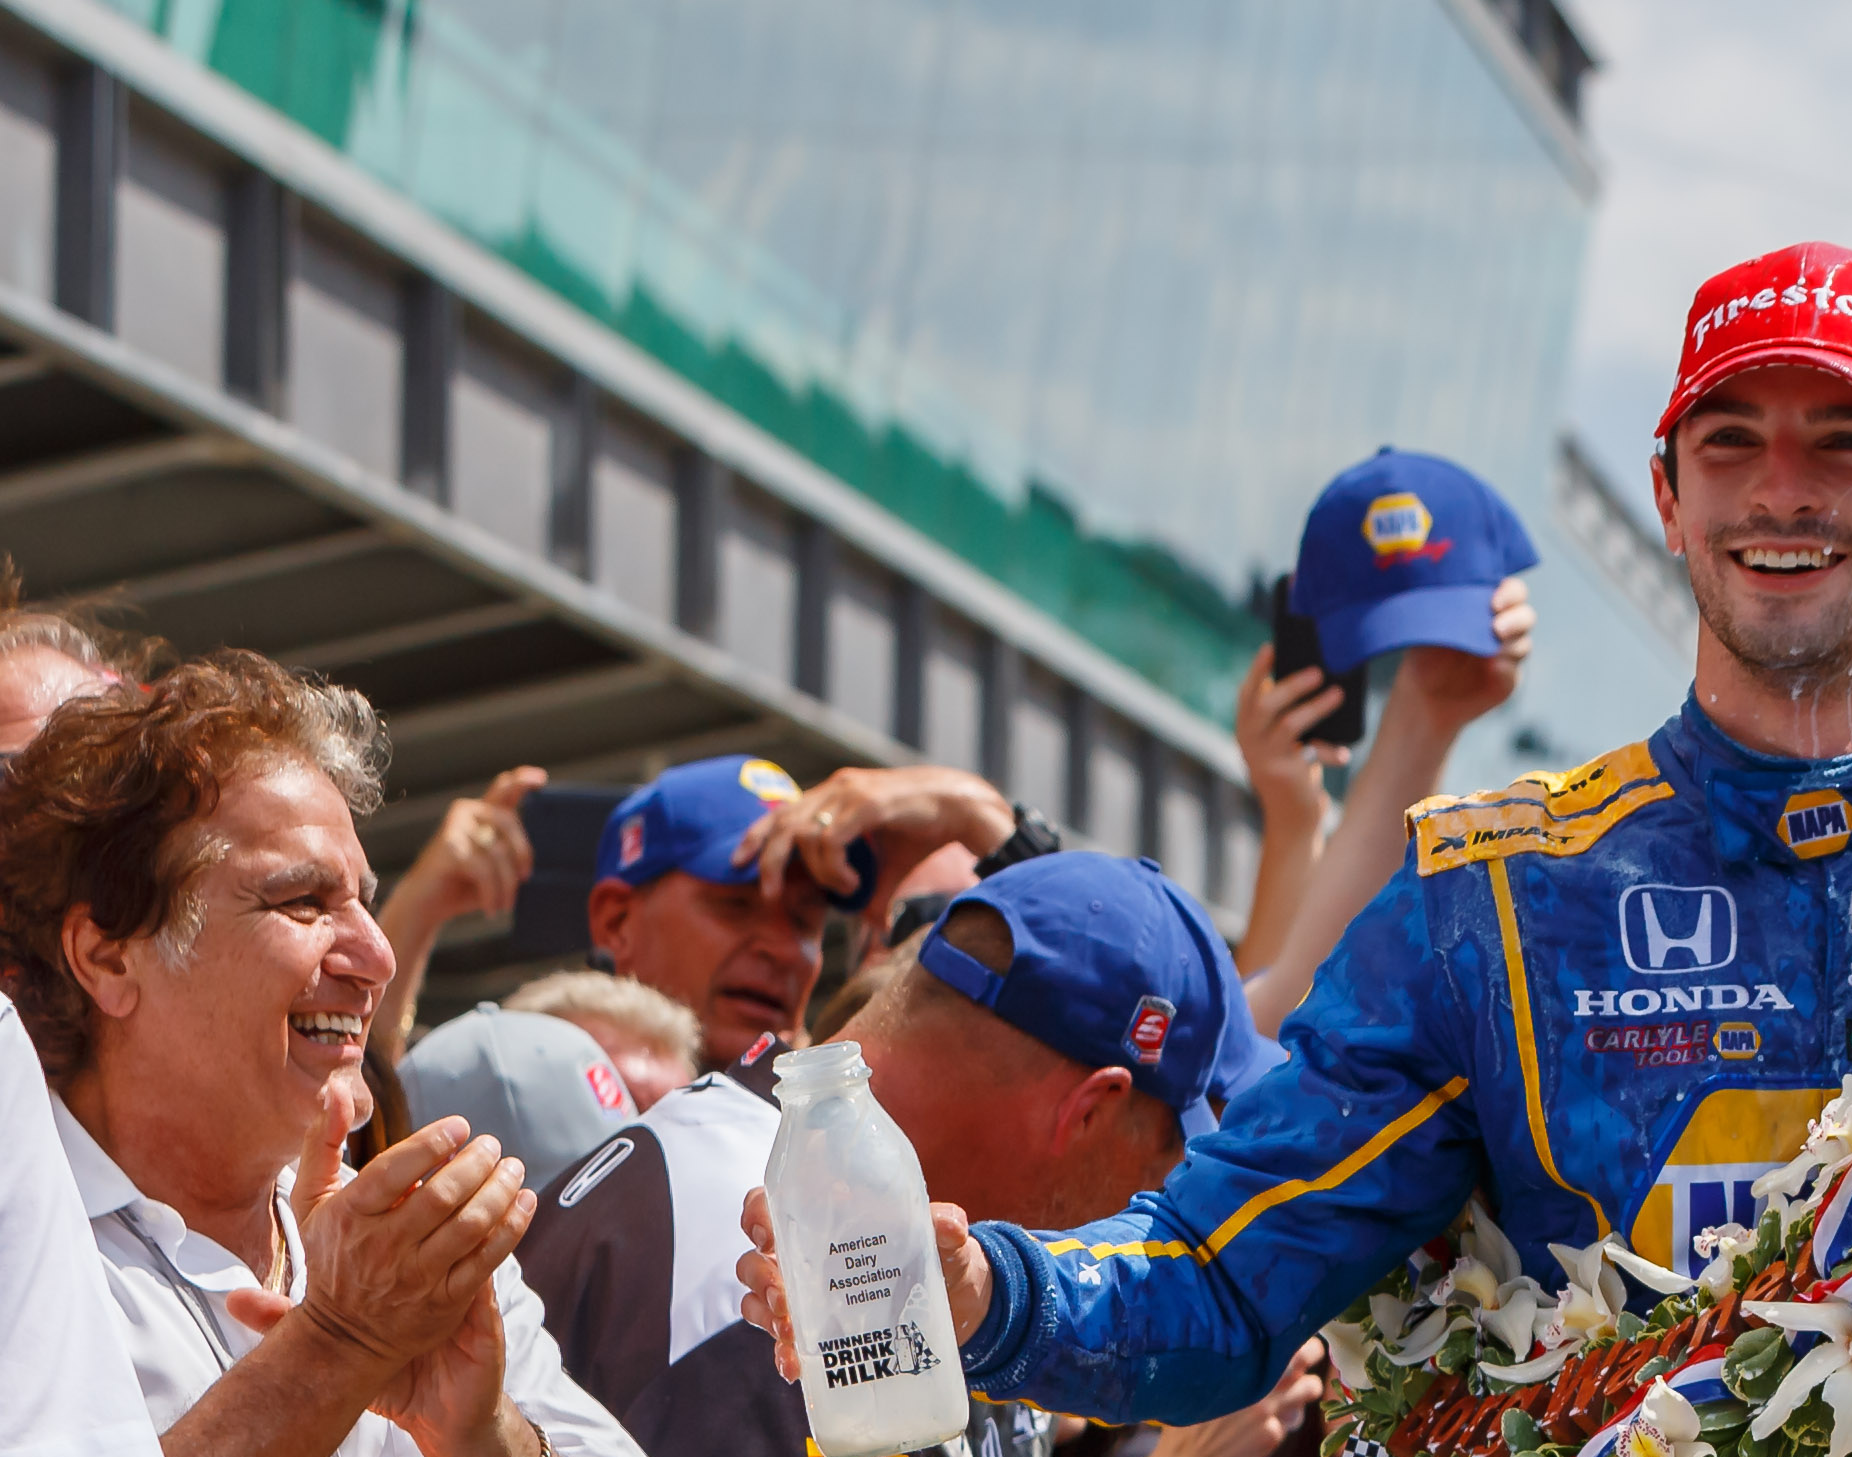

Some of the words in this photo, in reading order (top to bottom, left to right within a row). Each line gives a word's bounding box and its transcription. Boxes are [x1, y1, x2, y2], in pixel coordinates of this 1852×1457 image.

[1787, 803, 1848, 844] NAPA
[1573, 984, 1795, 1016] HONDA
[1586, 1024, 1708, 1050] CARLYLE
[1720, 1029, 1757, 1052] NAPA
[1635, 1049, 1706, 1068] TOOLS
[829, 1233, 887, 1256] American
[844, 1253, 877, 1271] Dairy
[828, 1267, 902, 1292] Association
[845, 1286, 892, 1306] Indiana
[818, 1327, 893, 1353] WINNERS
[821, 1340, 896, 1369] DRINK
[824, 1357, 897, 1389] MILK
